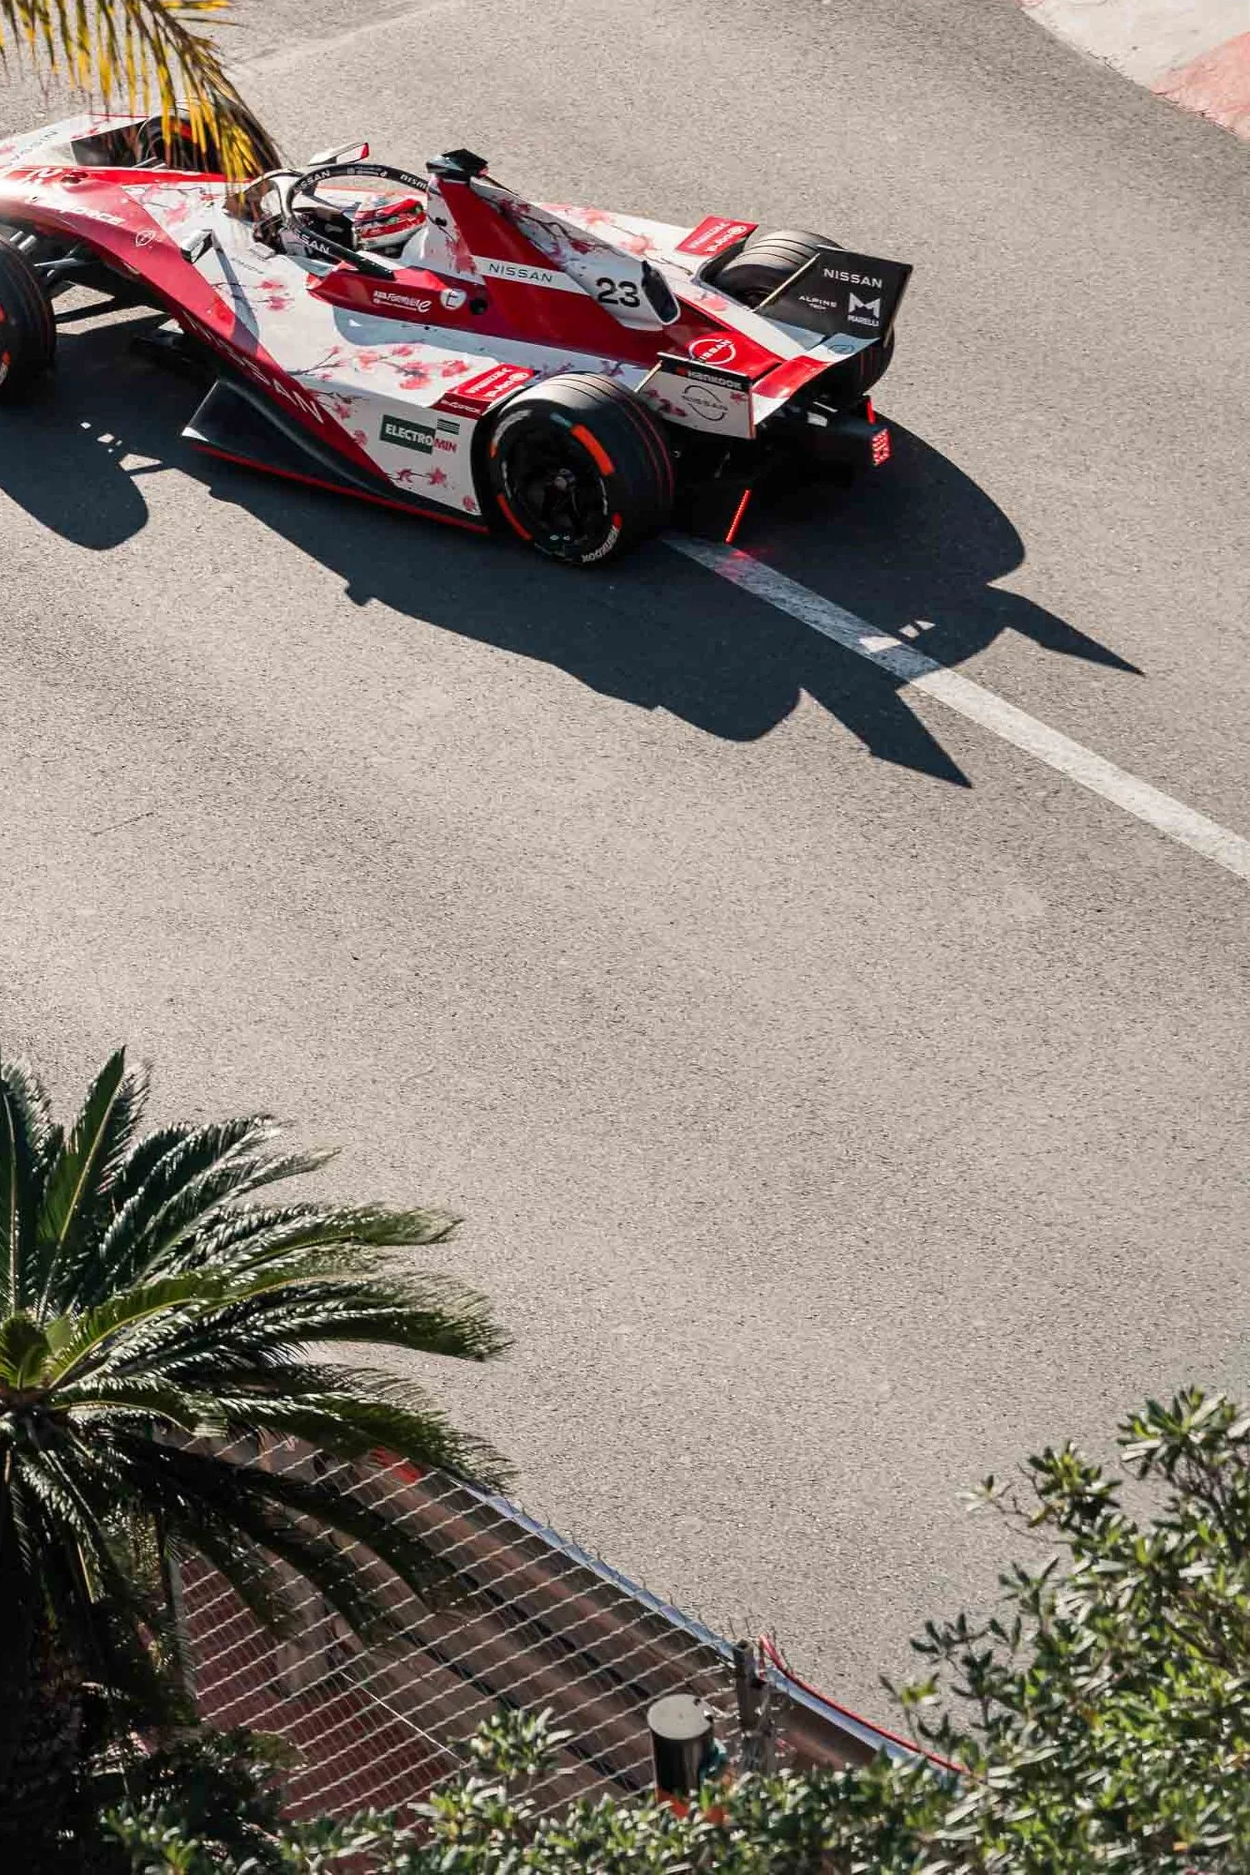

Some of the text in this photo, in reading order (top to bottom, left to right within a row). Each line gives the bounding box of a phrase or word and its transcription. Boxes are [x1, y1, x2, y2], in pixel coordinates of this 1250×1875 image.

[489, 263, 553, 283] NISSAN
[823, 268, 882, 289] NISSAN
[596, 277, 641, 309] 23
[798, 295, 837, 308] ALPINE
[847, 314, 880, 327] MARELLI
